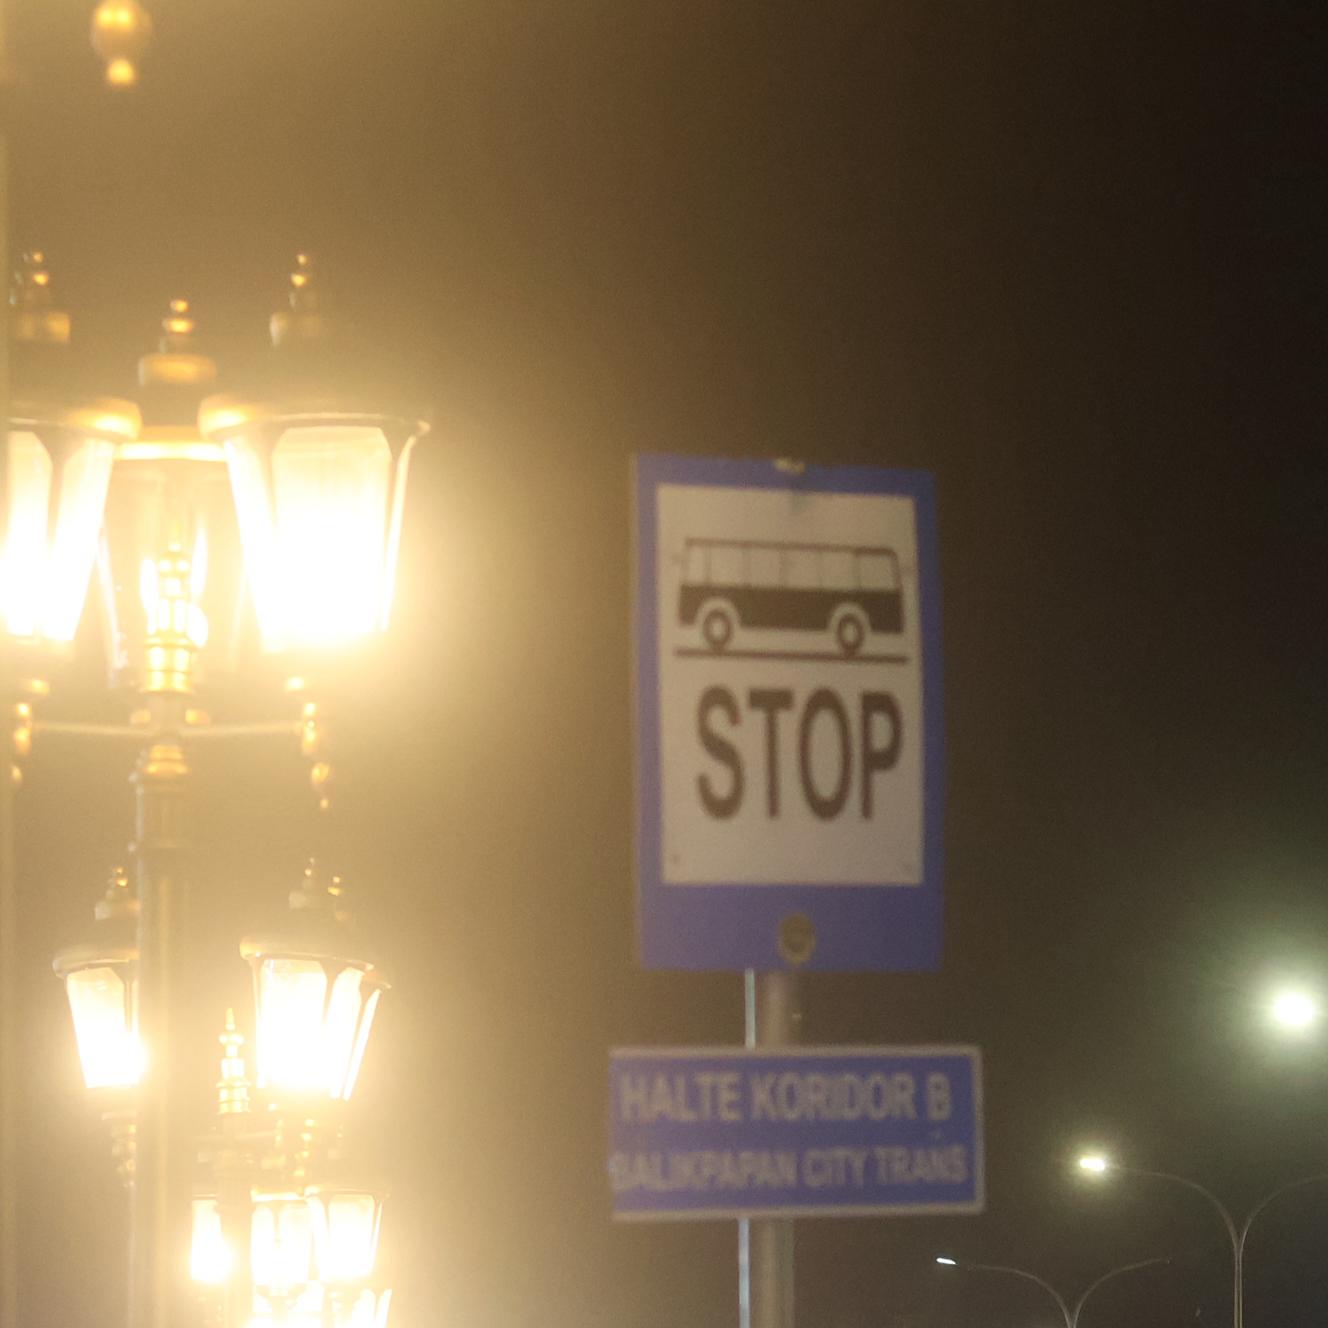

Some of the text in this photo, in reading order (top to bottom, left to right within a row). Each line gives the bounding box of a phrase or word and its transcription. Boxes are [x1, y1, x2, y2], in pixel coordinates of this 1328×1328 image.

[698, 685, 902, 821] STOP
[620, 1072, 952, 1121] HALTE KORIDOR B
[611, 1145, 967, 1190] BALIKPAPAN CITY TRANS
